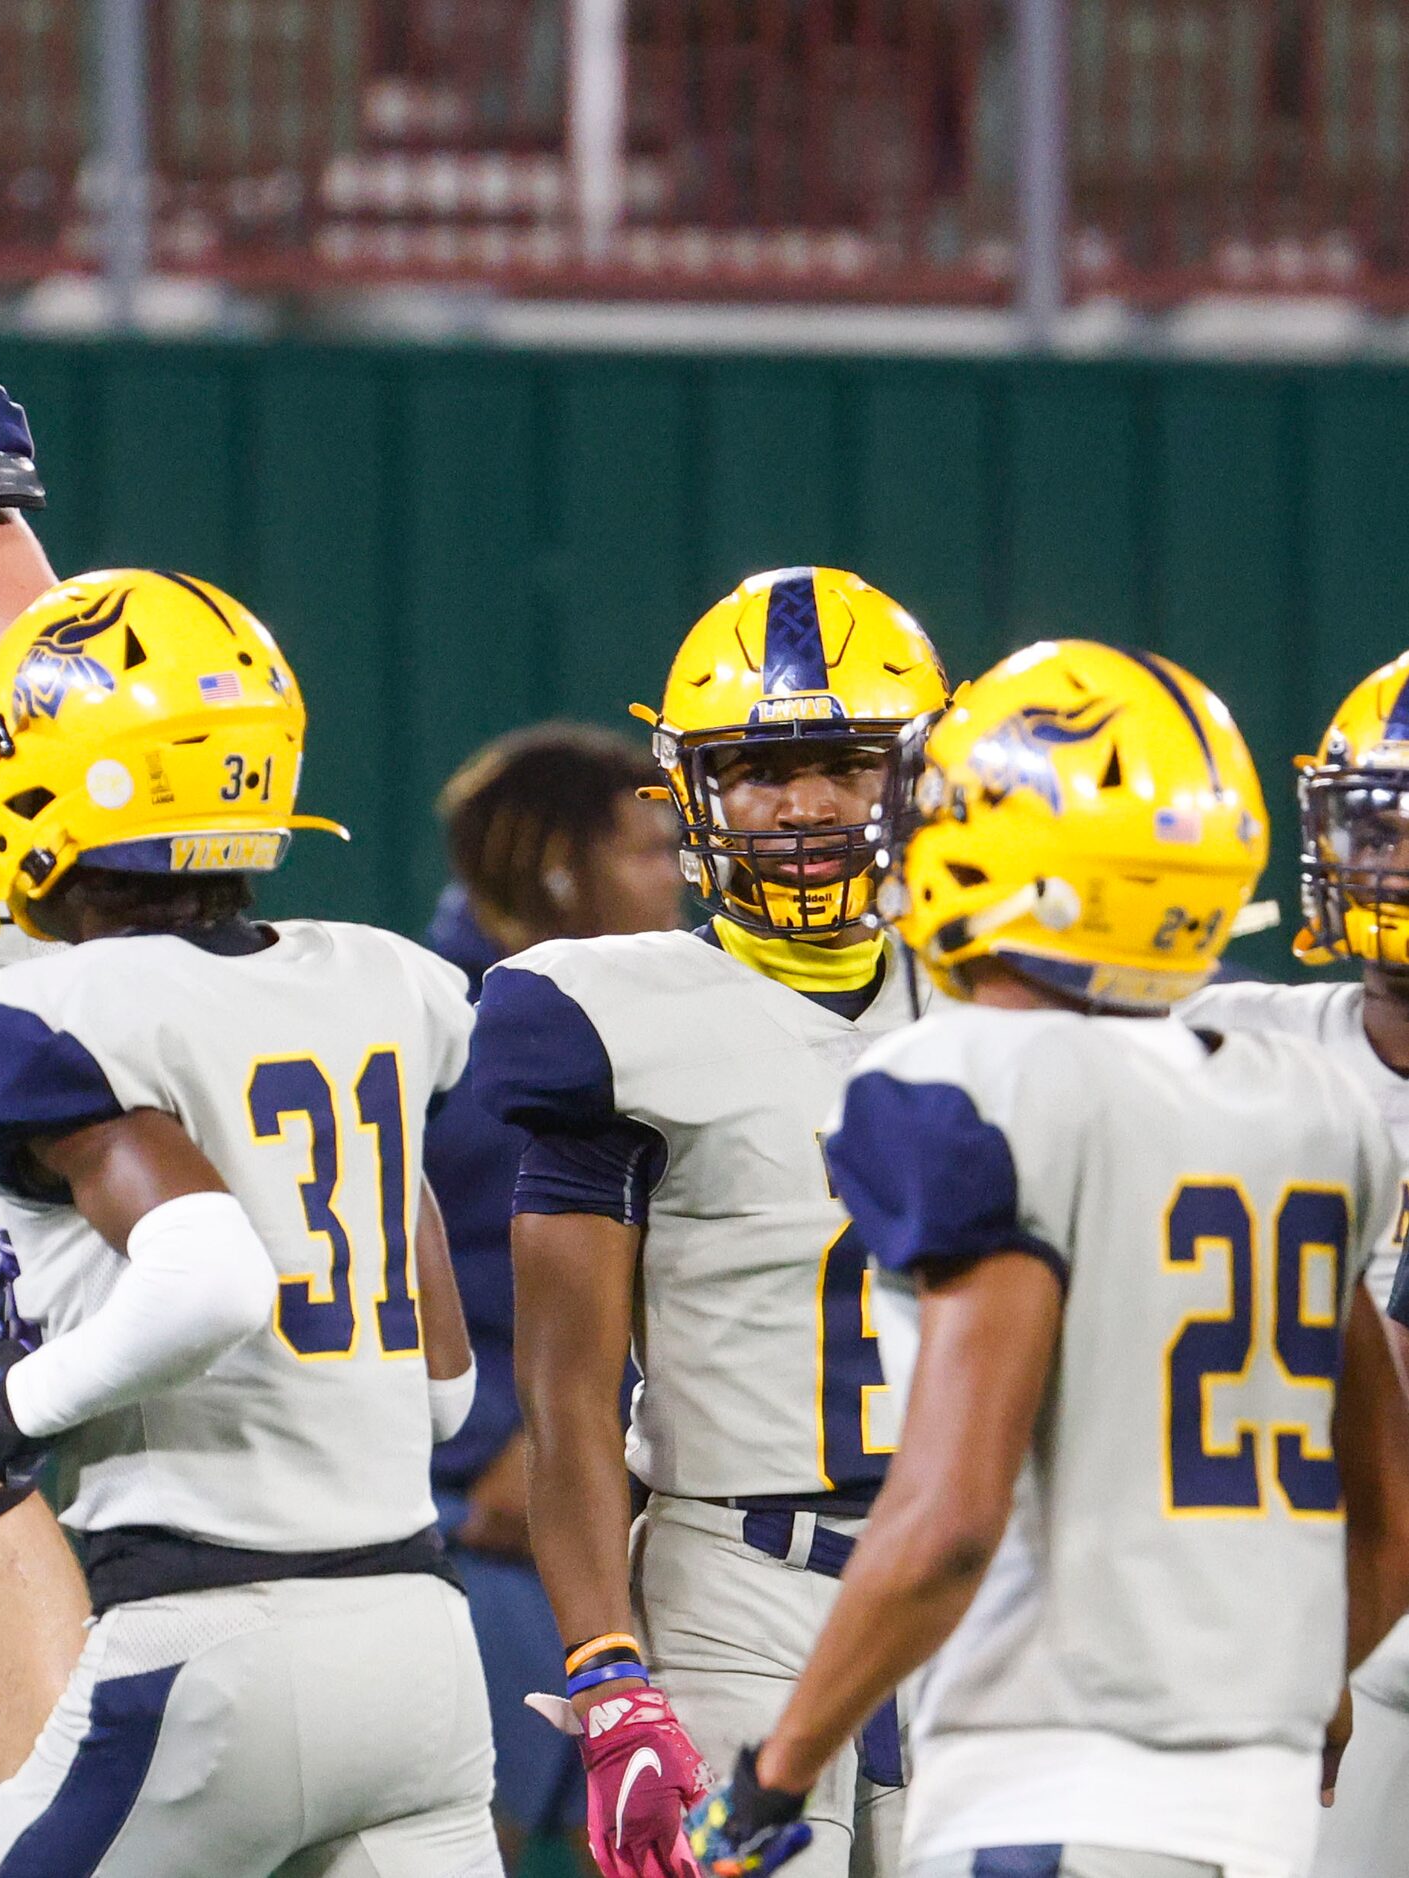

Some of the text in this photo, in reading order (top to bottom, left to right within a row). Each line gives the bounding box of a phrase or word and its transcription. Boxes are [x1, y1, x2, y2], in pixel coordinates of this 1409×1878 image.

[758, 696, 833, 723] LAMAR
[792, 892, 833, 904] Rddell
[242, 1042, 426, 1362] 31
[1161, 1172, 1354, 1522] 29
